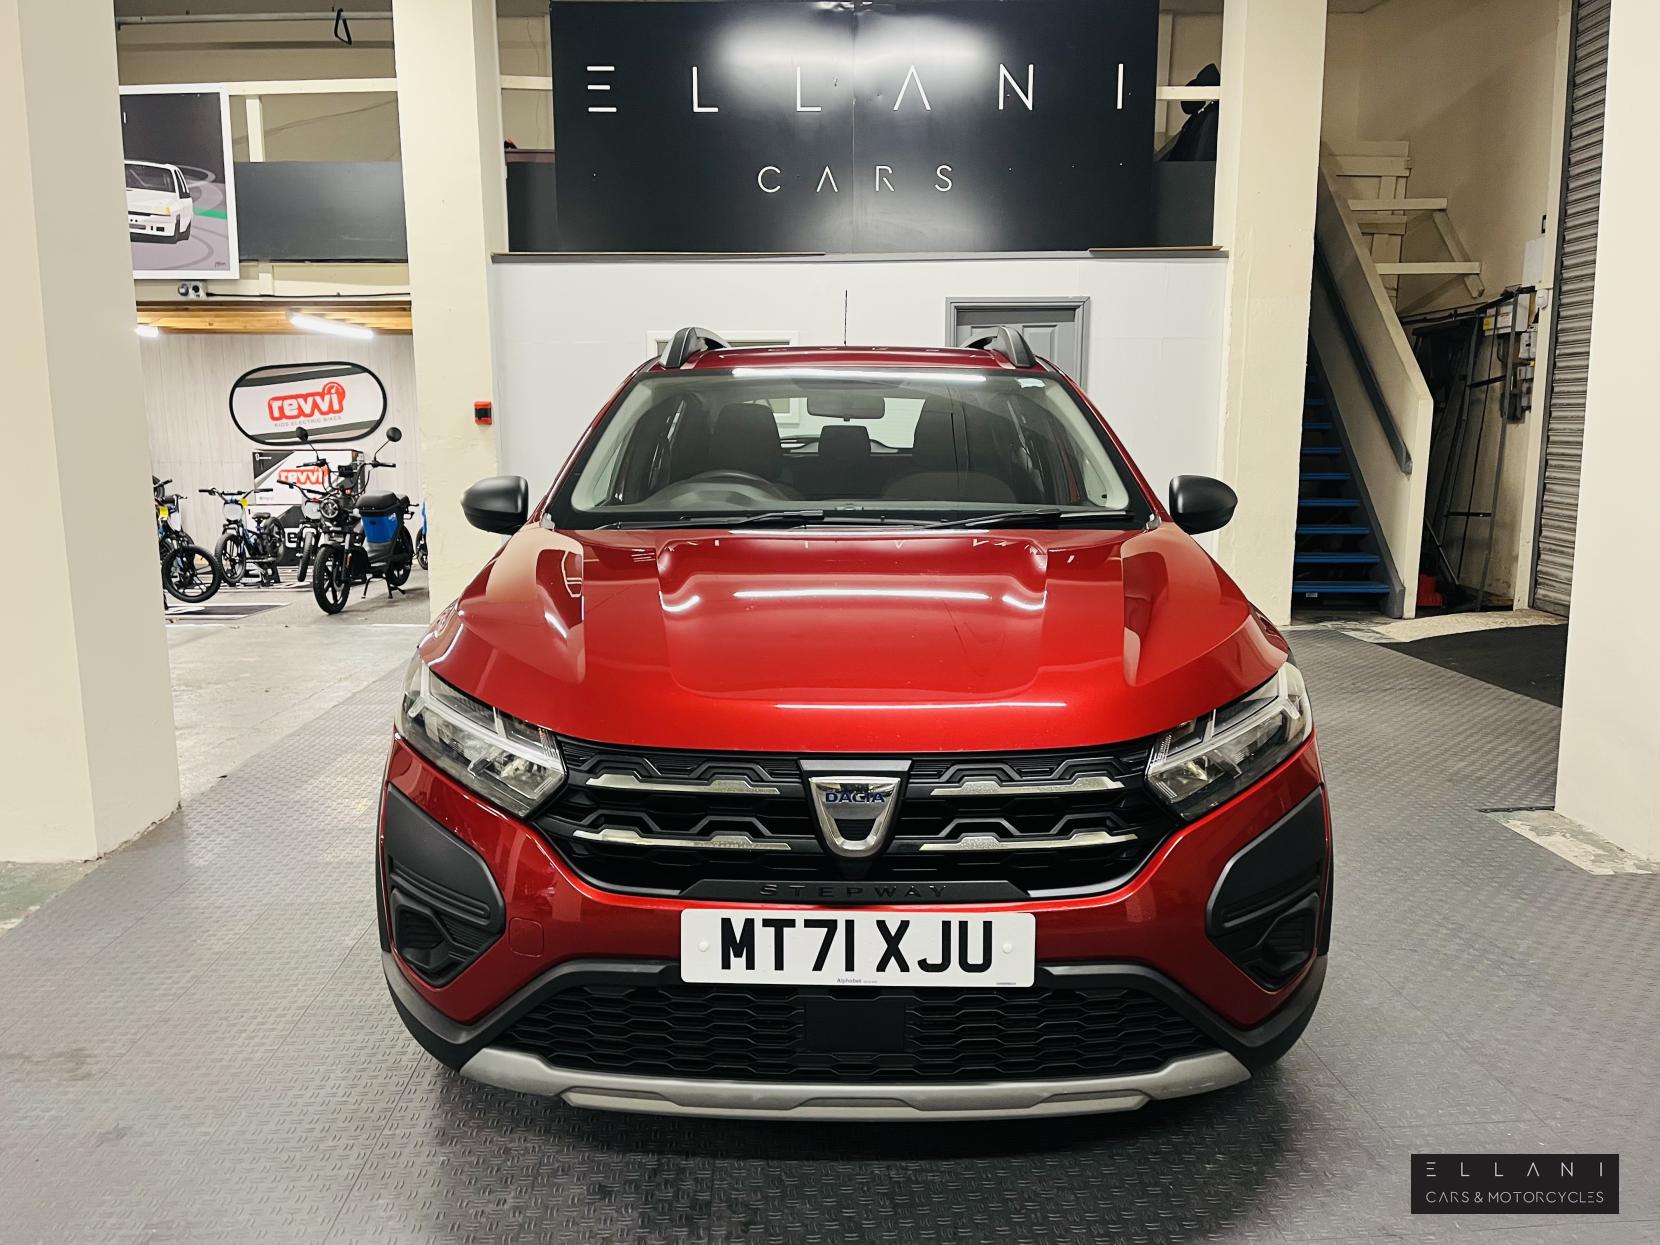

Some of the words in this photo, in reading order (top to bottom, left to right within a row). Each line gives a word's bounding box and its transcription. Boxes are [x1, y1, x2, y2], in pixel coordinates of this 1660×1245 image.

[586, 63, 1124, 113] ELLANI
[757, 164, 953, 193] CARS
[269, 384, 342, 418] revvi
[825, 792, 885, 803] DACIA
[759, 884, 947, 899] STEPWAY
[721, 917, 855, 972] MT71
[876, 919, 993, 973] XJU
